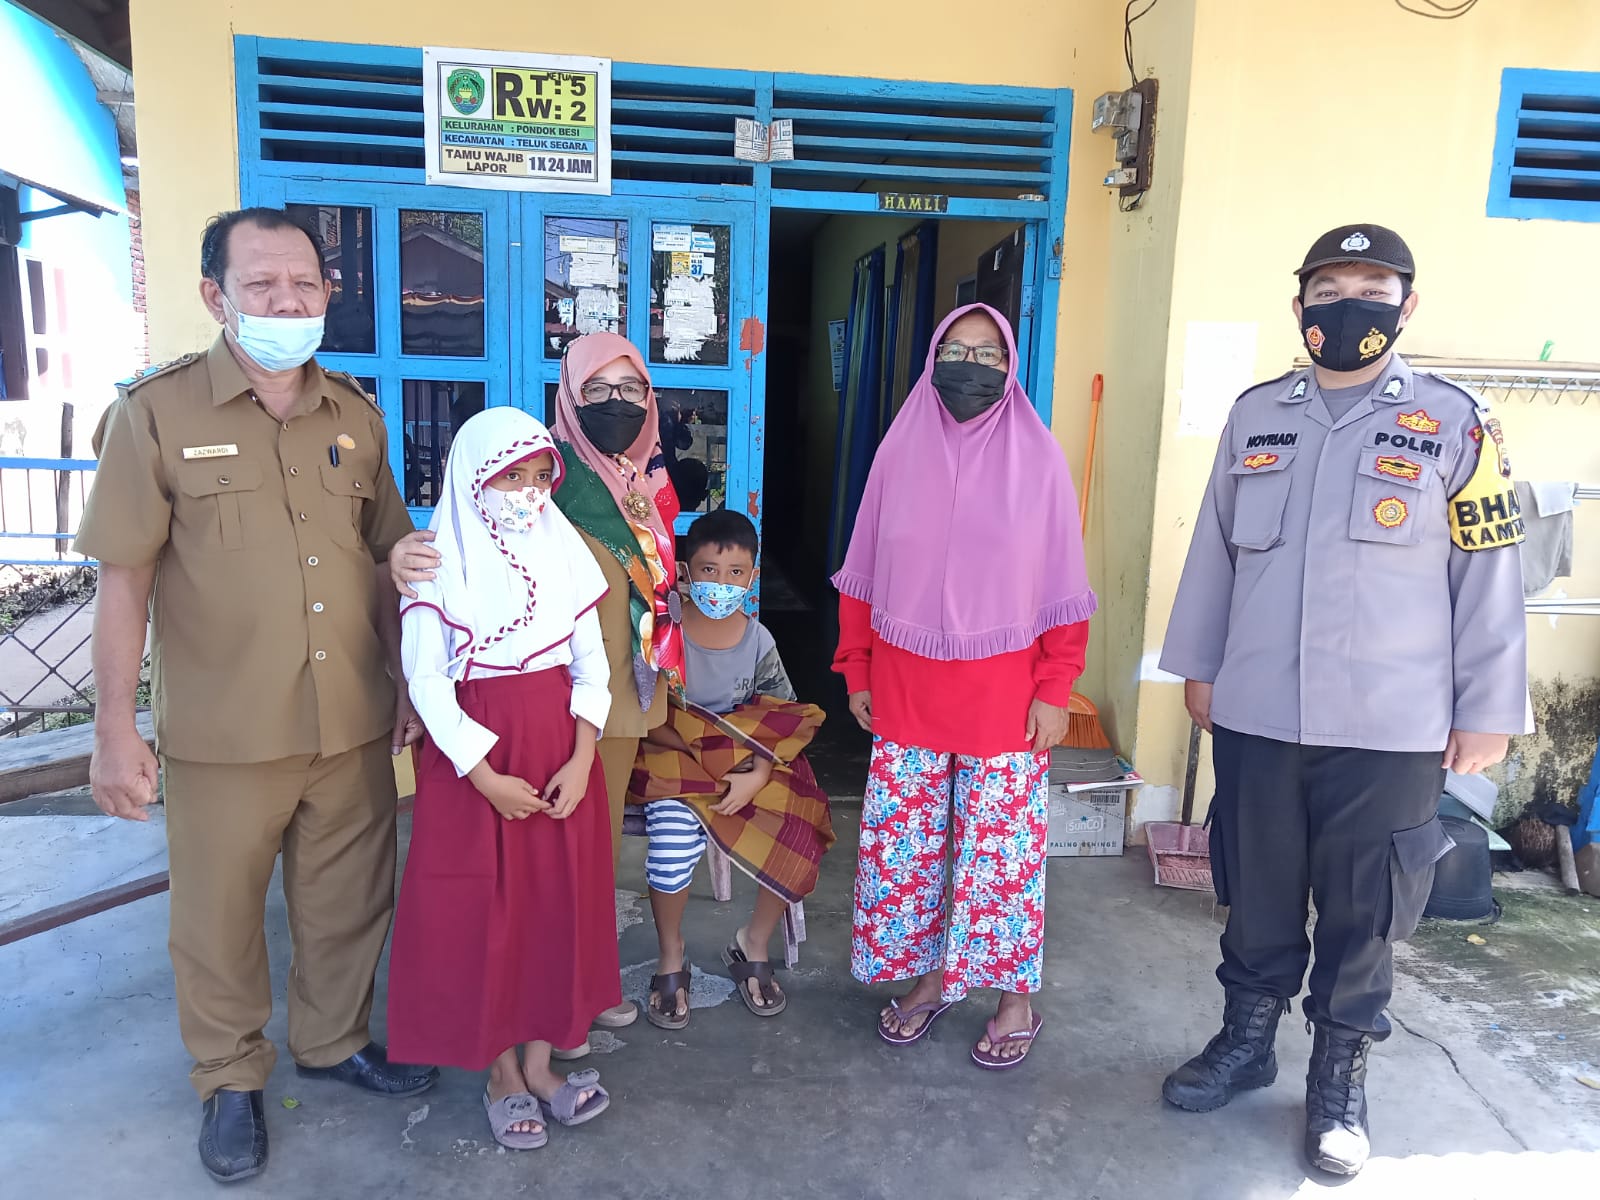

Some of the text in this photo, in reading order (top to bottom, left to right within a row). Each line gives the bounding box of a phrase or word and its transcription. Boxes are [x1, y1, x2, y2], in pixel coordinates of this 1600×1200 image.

[445, 120, 504, 132] KELURAHAN
[516, 125, 556, 136] PONDOK
[558, 126, 580, 137] BESI
[445, 134, 505, 146] KECAMATAN
[516, 138, 548, 149] TELUK
[550, 140, 588, 151] SEGARA
[445, 149, 524, 163] TAMU WAJIB
[466, 162, 508, 173] LAPOR
[528, 157, 534, 171] 1
[548, 157, 566, 172] 24
[567, 158, 592, 174] JAM
[884, 195, 941, 212] HAMLI
[691, 264, 703, 275] 37
[1246, 432, 1298, 449] NOVRIADI
[1374, 432, 1443, 458] POLRI
